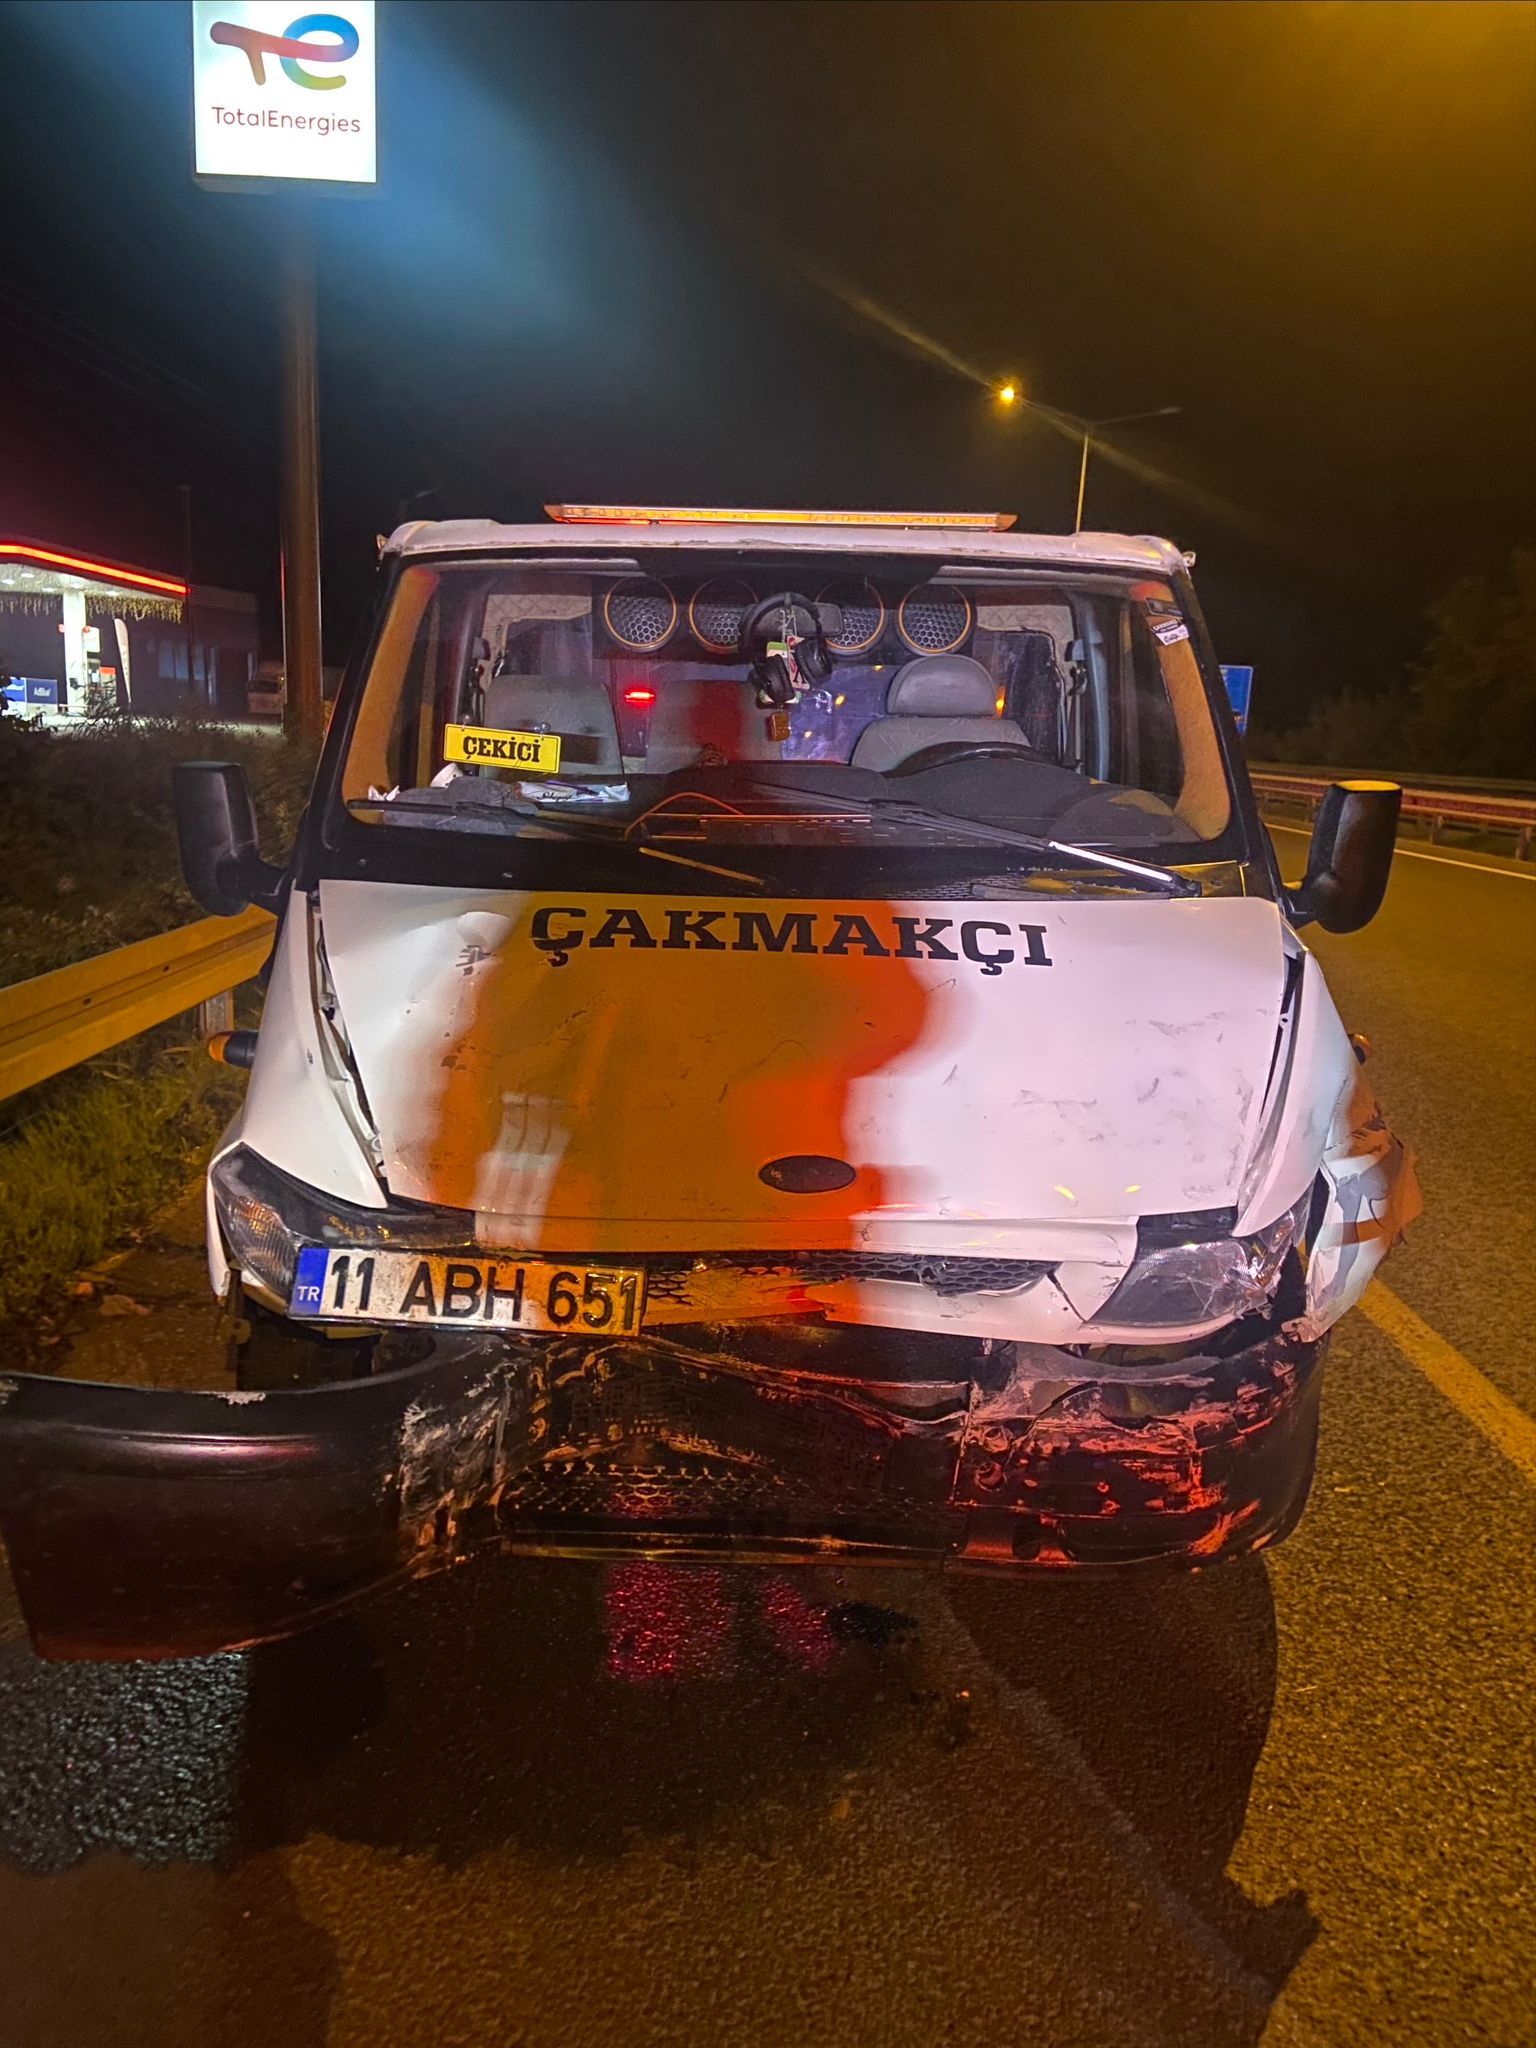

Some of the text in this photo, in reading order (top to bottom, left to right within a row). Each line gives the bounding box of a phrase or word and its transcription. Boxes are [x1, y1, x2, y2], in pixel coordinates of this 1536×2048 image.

[211, 106, 361, 136] TotalEnergies
[463, 736, 541, 763] ÇEKİCİ
[531, 907, 1053, 975] ÇAKMAKÇI
[297, 1286, 320, 1302] TR
[332, 1255, 637, 1331] 11 ABH 651
